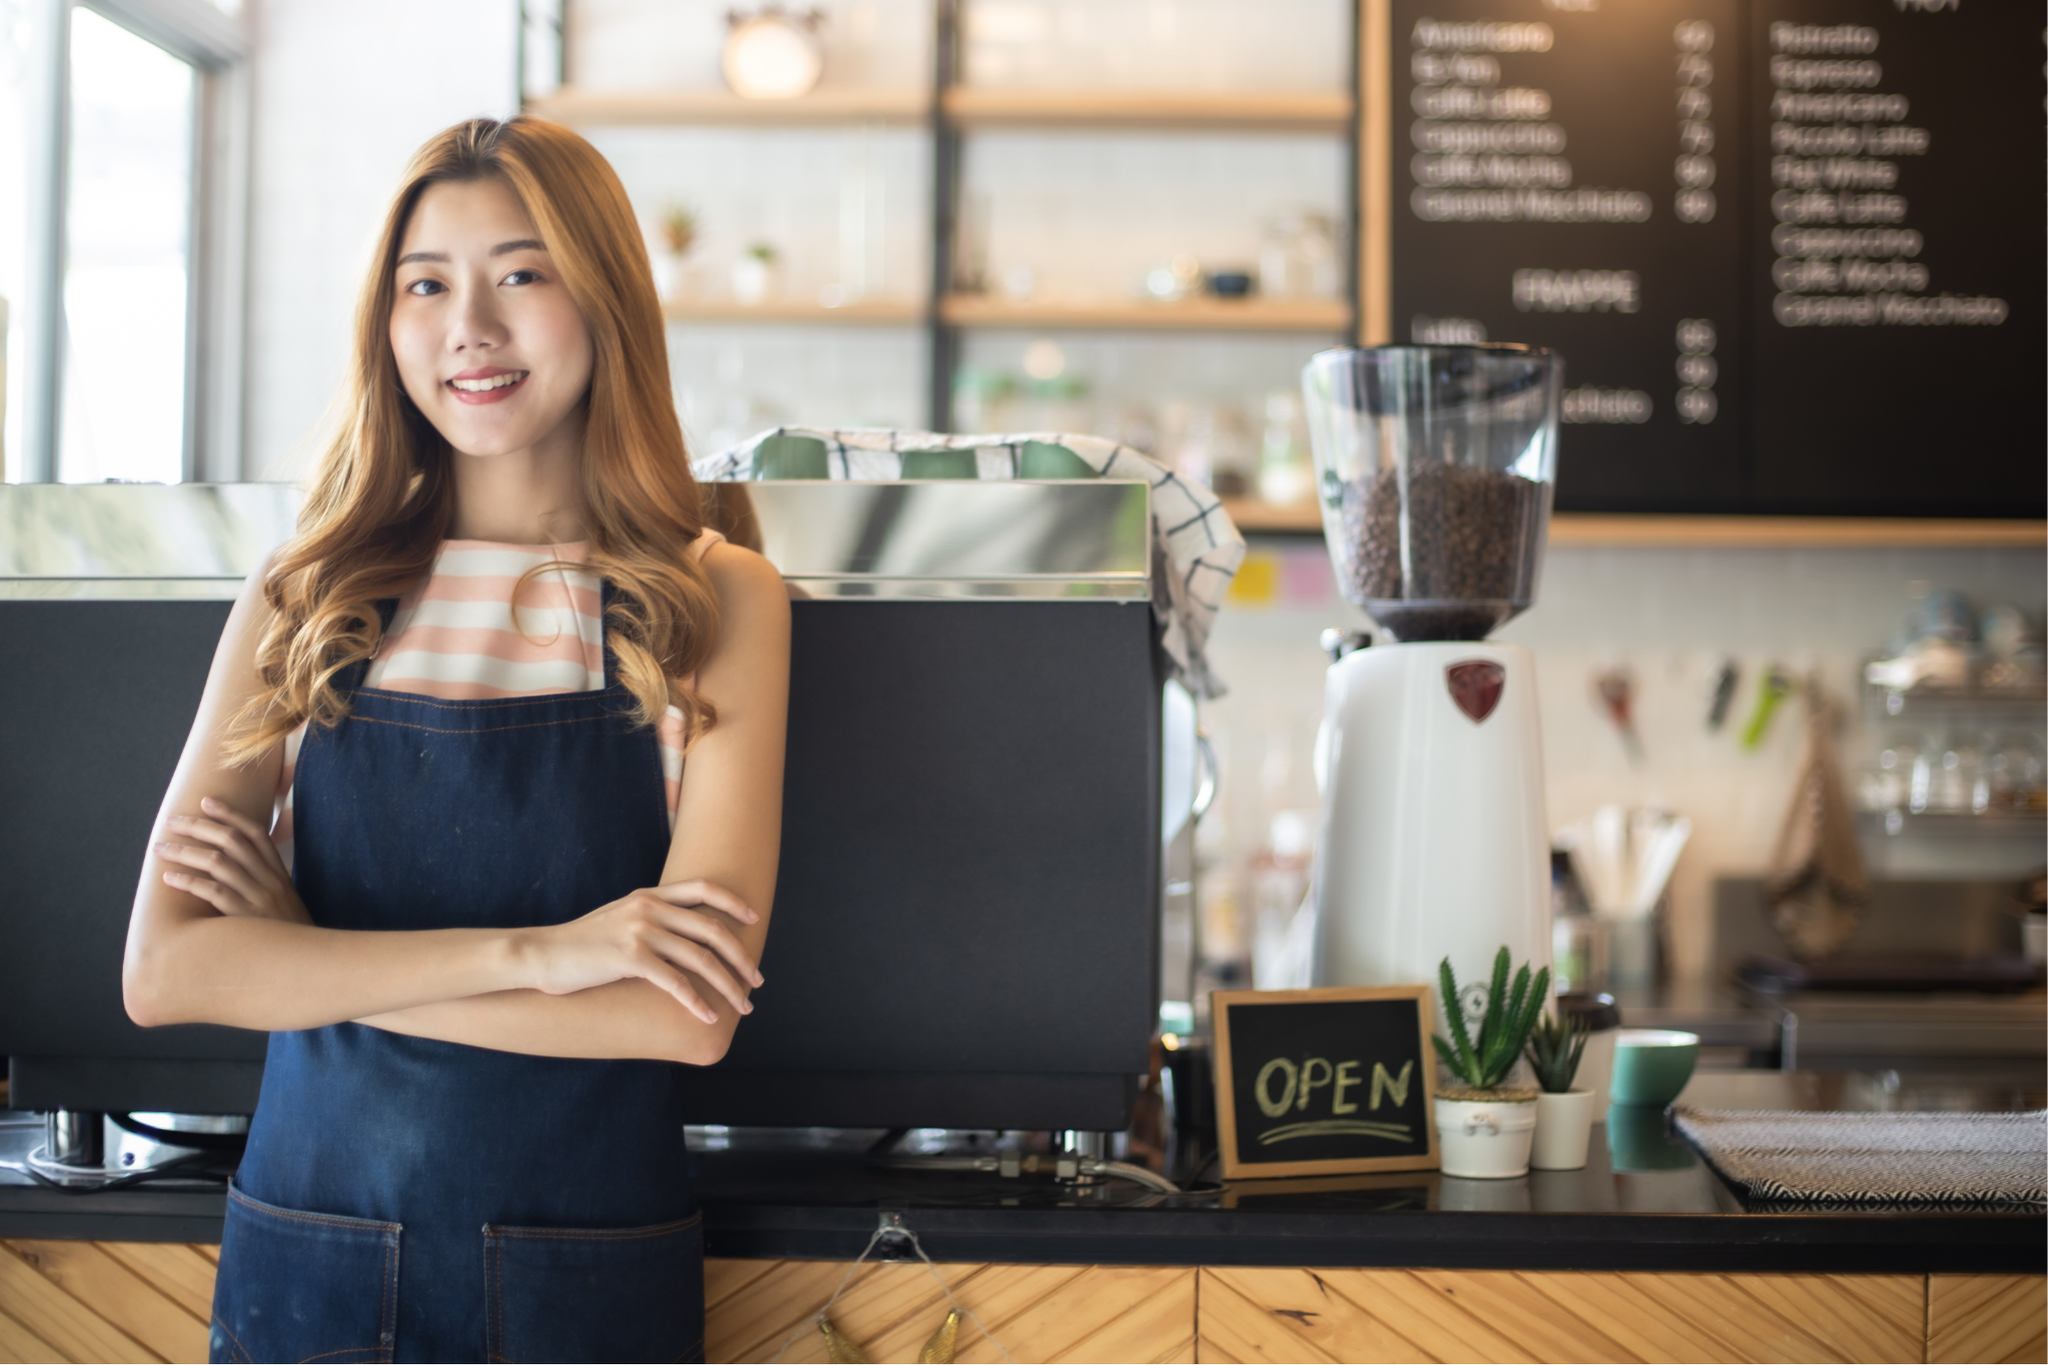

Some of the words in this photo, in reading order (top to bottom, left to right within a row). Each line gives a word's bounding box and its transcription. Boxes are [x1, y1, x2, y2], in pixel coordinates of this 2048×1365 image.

[1412, 17, 1554, 52] Americano
[1770, 20, 1880, 54] Ristretto
[1770, 54, 1883, 90] Espresso
[1478, 86, 1552, 120] Latte
[1770, 88, 1910, 122] Americano
[1411, 117, 1567, 154] Cappuccino
[1771, 121, 1864, 156] Piccolo
[1861, 122, 1931, 156] Latte
[1480, 154, 1573, 189] Mocha
[1771, 154, 1823, 190] Flat
[1819, 156, 1899, 190] White
[1411, 184, 1520, 222] Caramel
[1516, 186, 1653, 223] Macchiato
[1838, 189, 1908, 224] Latte
[1771, 222, 1924, 258] Cappuccino
[1512, 268, 1641, 313] FRAPPE
[1838, 258, 1930, 292] Mocha
[1772, 290, 1879, 327] Caramel
[1876, 291, 2010, 327] Macchiato
[1255, 1057, 1414, 1118] OPEN
